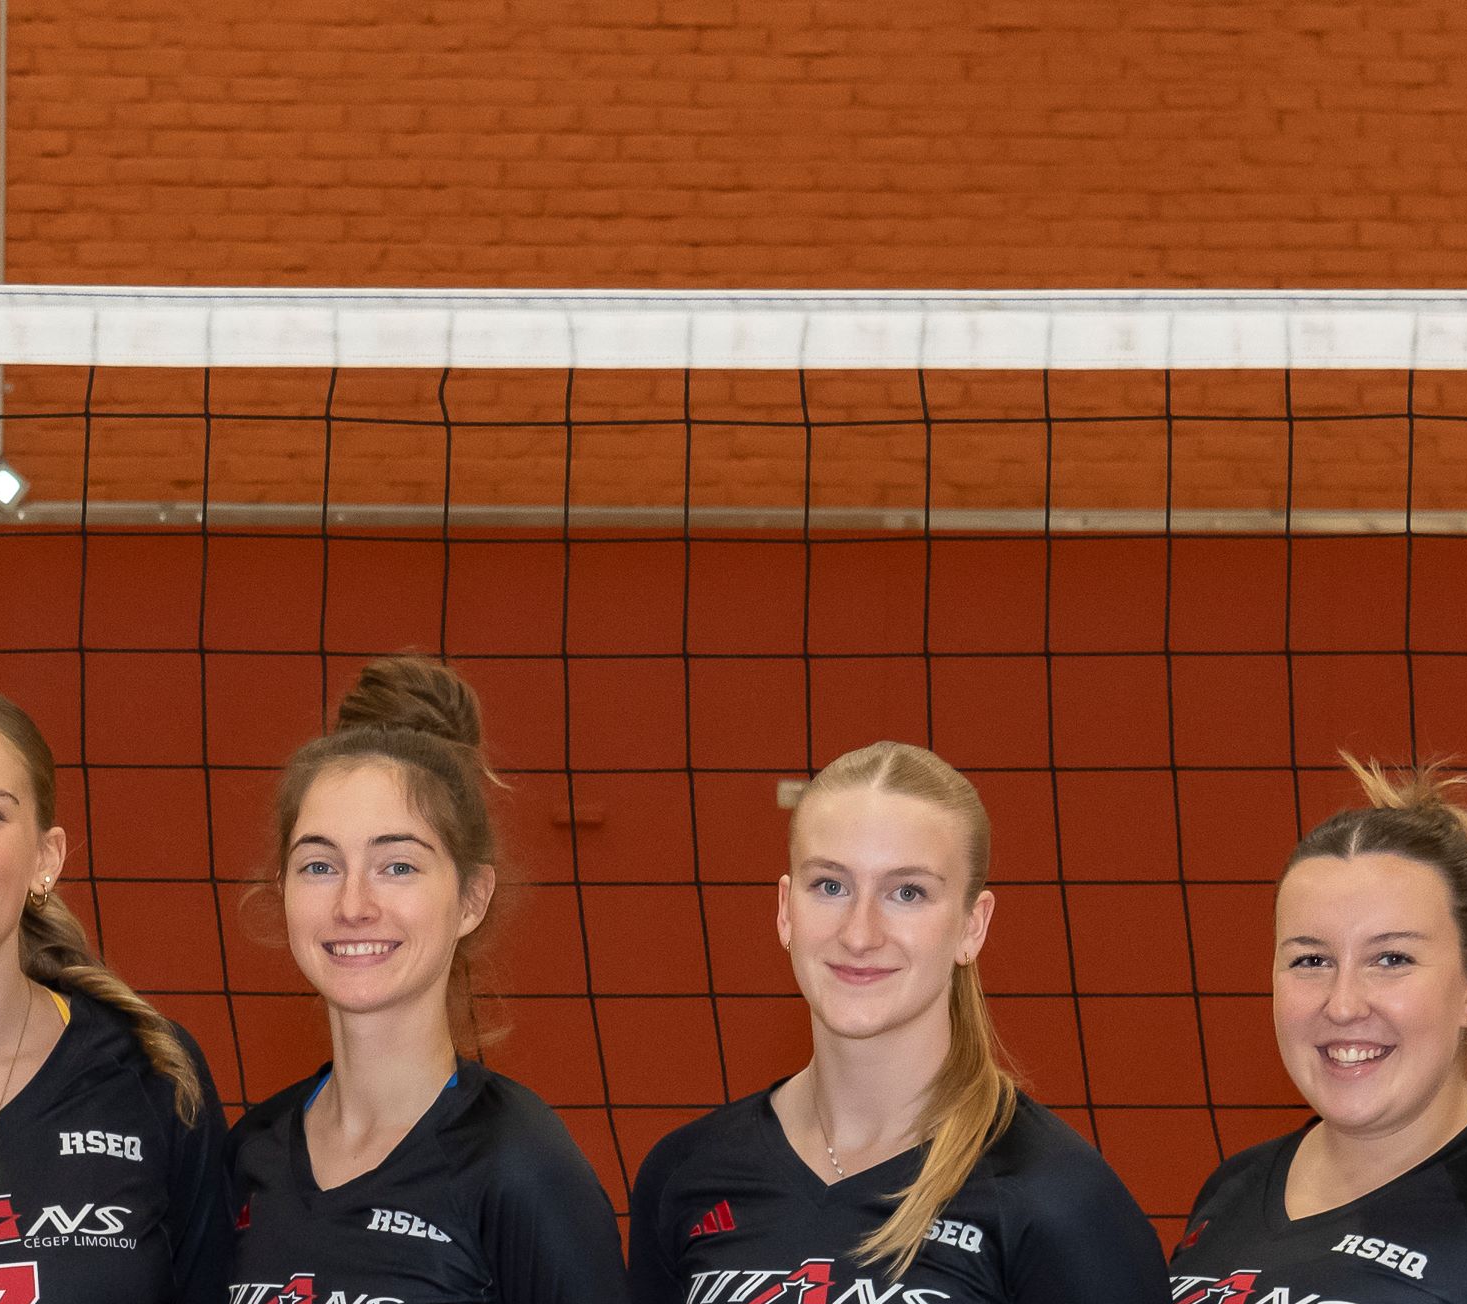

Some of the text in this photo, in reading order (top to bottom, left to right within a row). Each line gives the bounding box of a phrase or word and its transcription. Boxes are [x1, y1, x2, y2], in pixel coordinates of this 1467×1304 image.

[58, 1130, 144, 1162] RSEQ
[23, 1233, 138, 1252] CÉGEP LIMOILOU
[922, 1218, 986, 1254] SEQ
[1330, 1234, 1429, 1280] RSEQ
